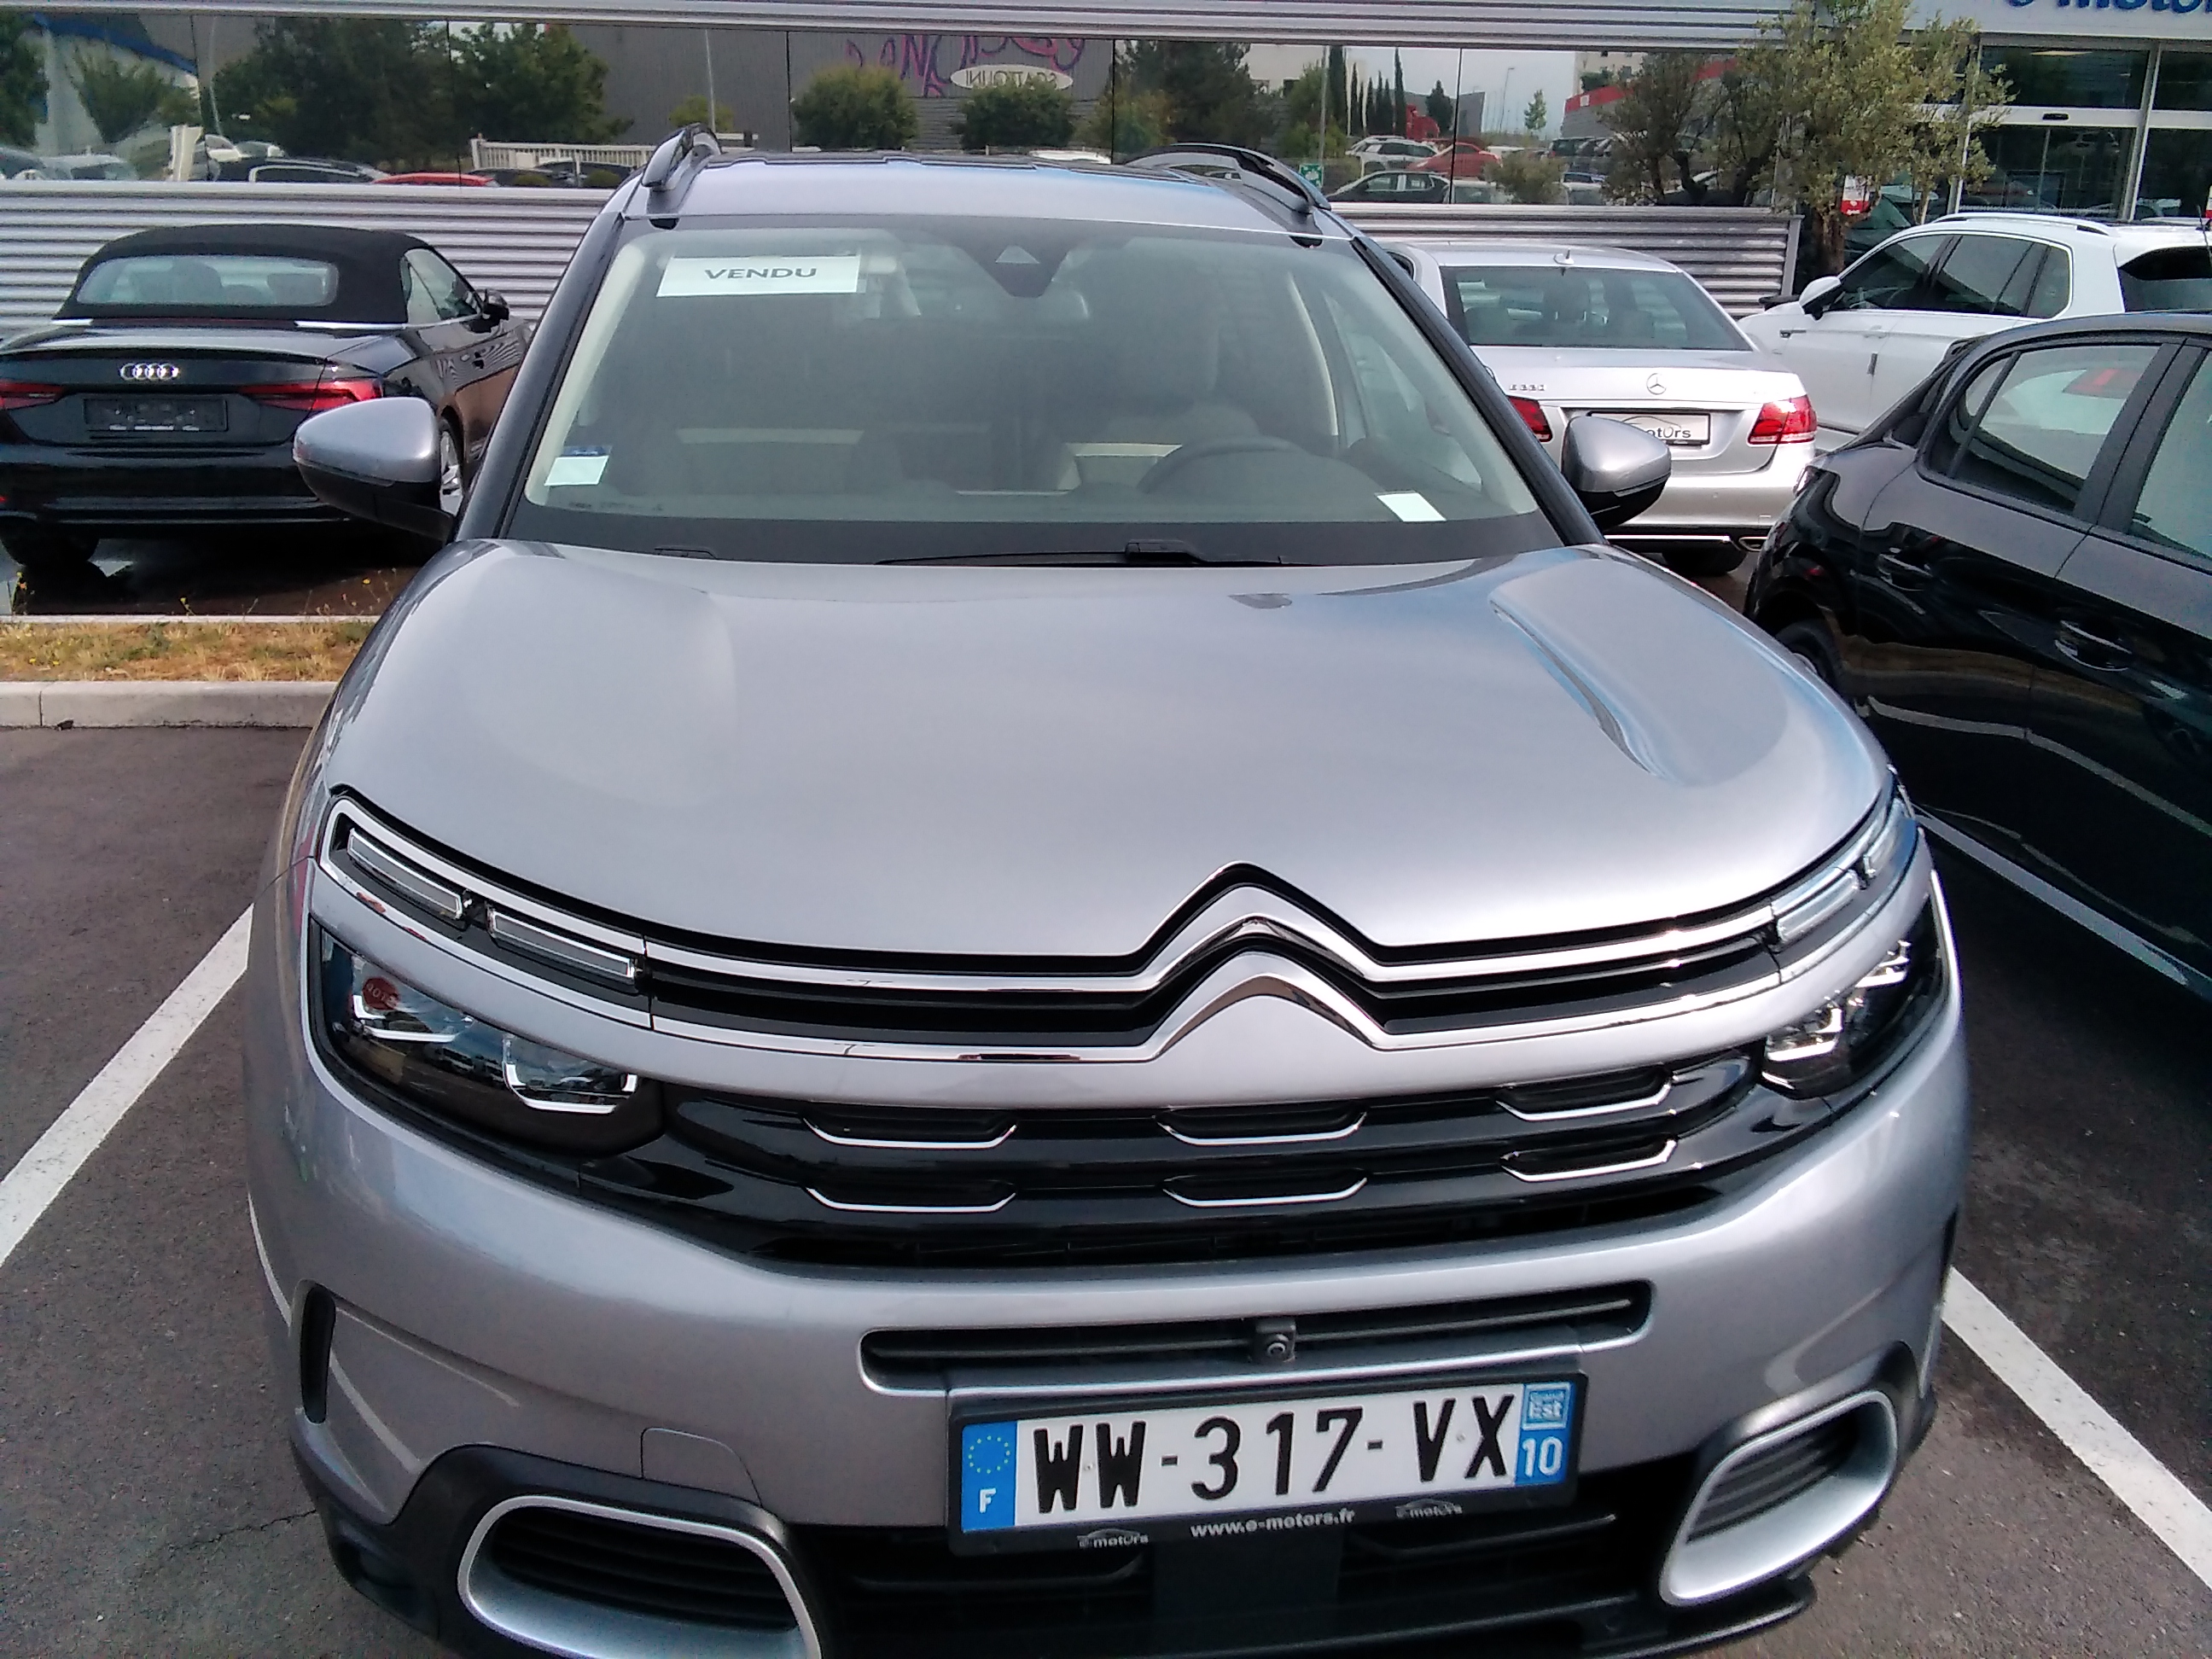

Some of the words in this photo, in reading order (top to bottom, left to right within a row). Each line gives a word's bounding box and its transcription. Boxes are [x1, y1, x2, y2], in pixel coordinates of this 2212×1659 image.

[704, 267, 818, 279] VENDU
[1522, 1435, 1563, 1477] 10
[979, 1488, 997, 1514] F
[1190, 1507, 1355, 1537] www.e-motors.fr
